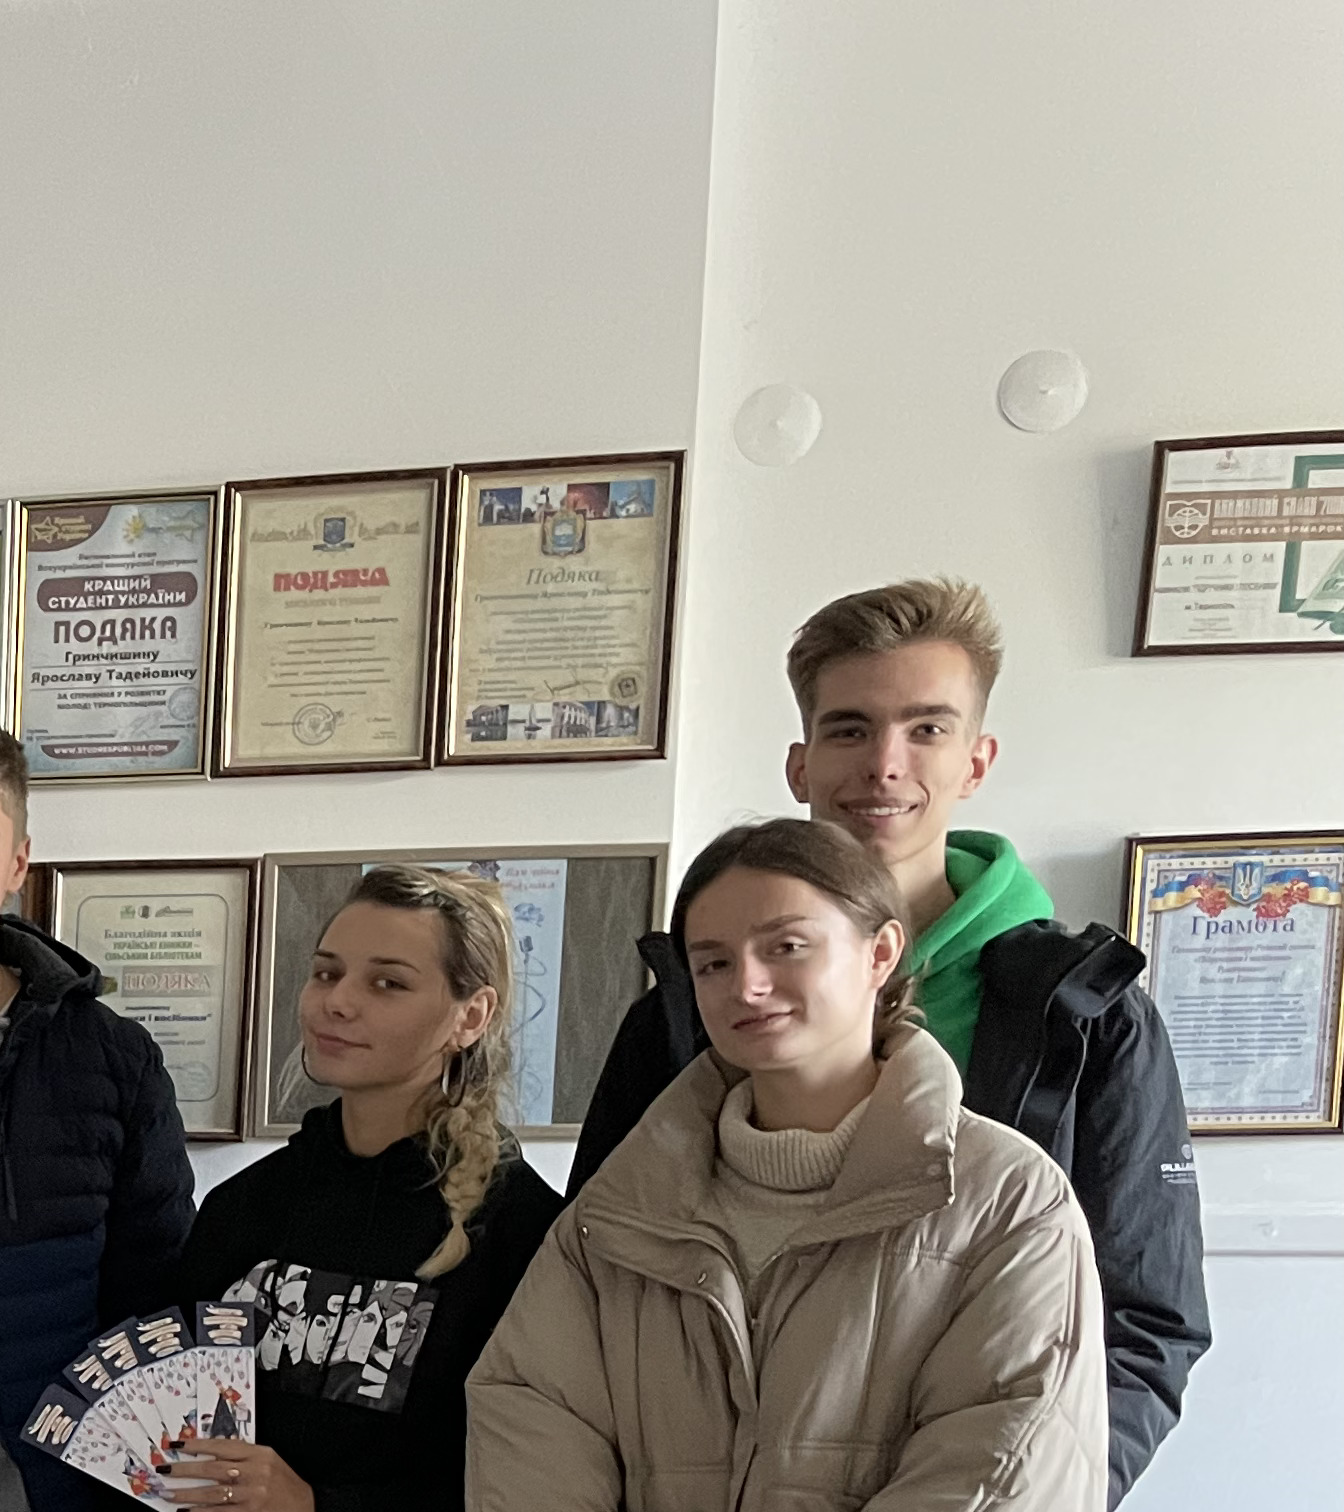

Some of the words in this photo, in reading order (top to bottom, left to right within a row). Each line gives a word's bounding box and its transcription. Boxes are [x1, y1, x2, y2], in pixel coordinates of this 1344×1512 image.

[1162, 553, 1274, 566] ДИПЛОМ
[83, 575, 151, 592] КРАЩИЙ
[273, 566, 390, 593] ПОДЯКА
[526, 566, 601, 585] Подяка
[48, 595, 114, 609] СТУДЕНТ
[119, 590, 186, 606] УКРАЇНИ
[53, 615, 178, 647] ПОДЯКА
[64, 650, 160, 666] Гринчишину
[30, 671, 102, 686] Ярославу
[106, 667, 198, 684] Тадейовичу
[104, 928, 167, 939] Благодійна
[170, 928, 202, 938] акція
[1191, 915, 1295, 940] Грамота
[124, 972, 211, 993] ПОДЯКА
